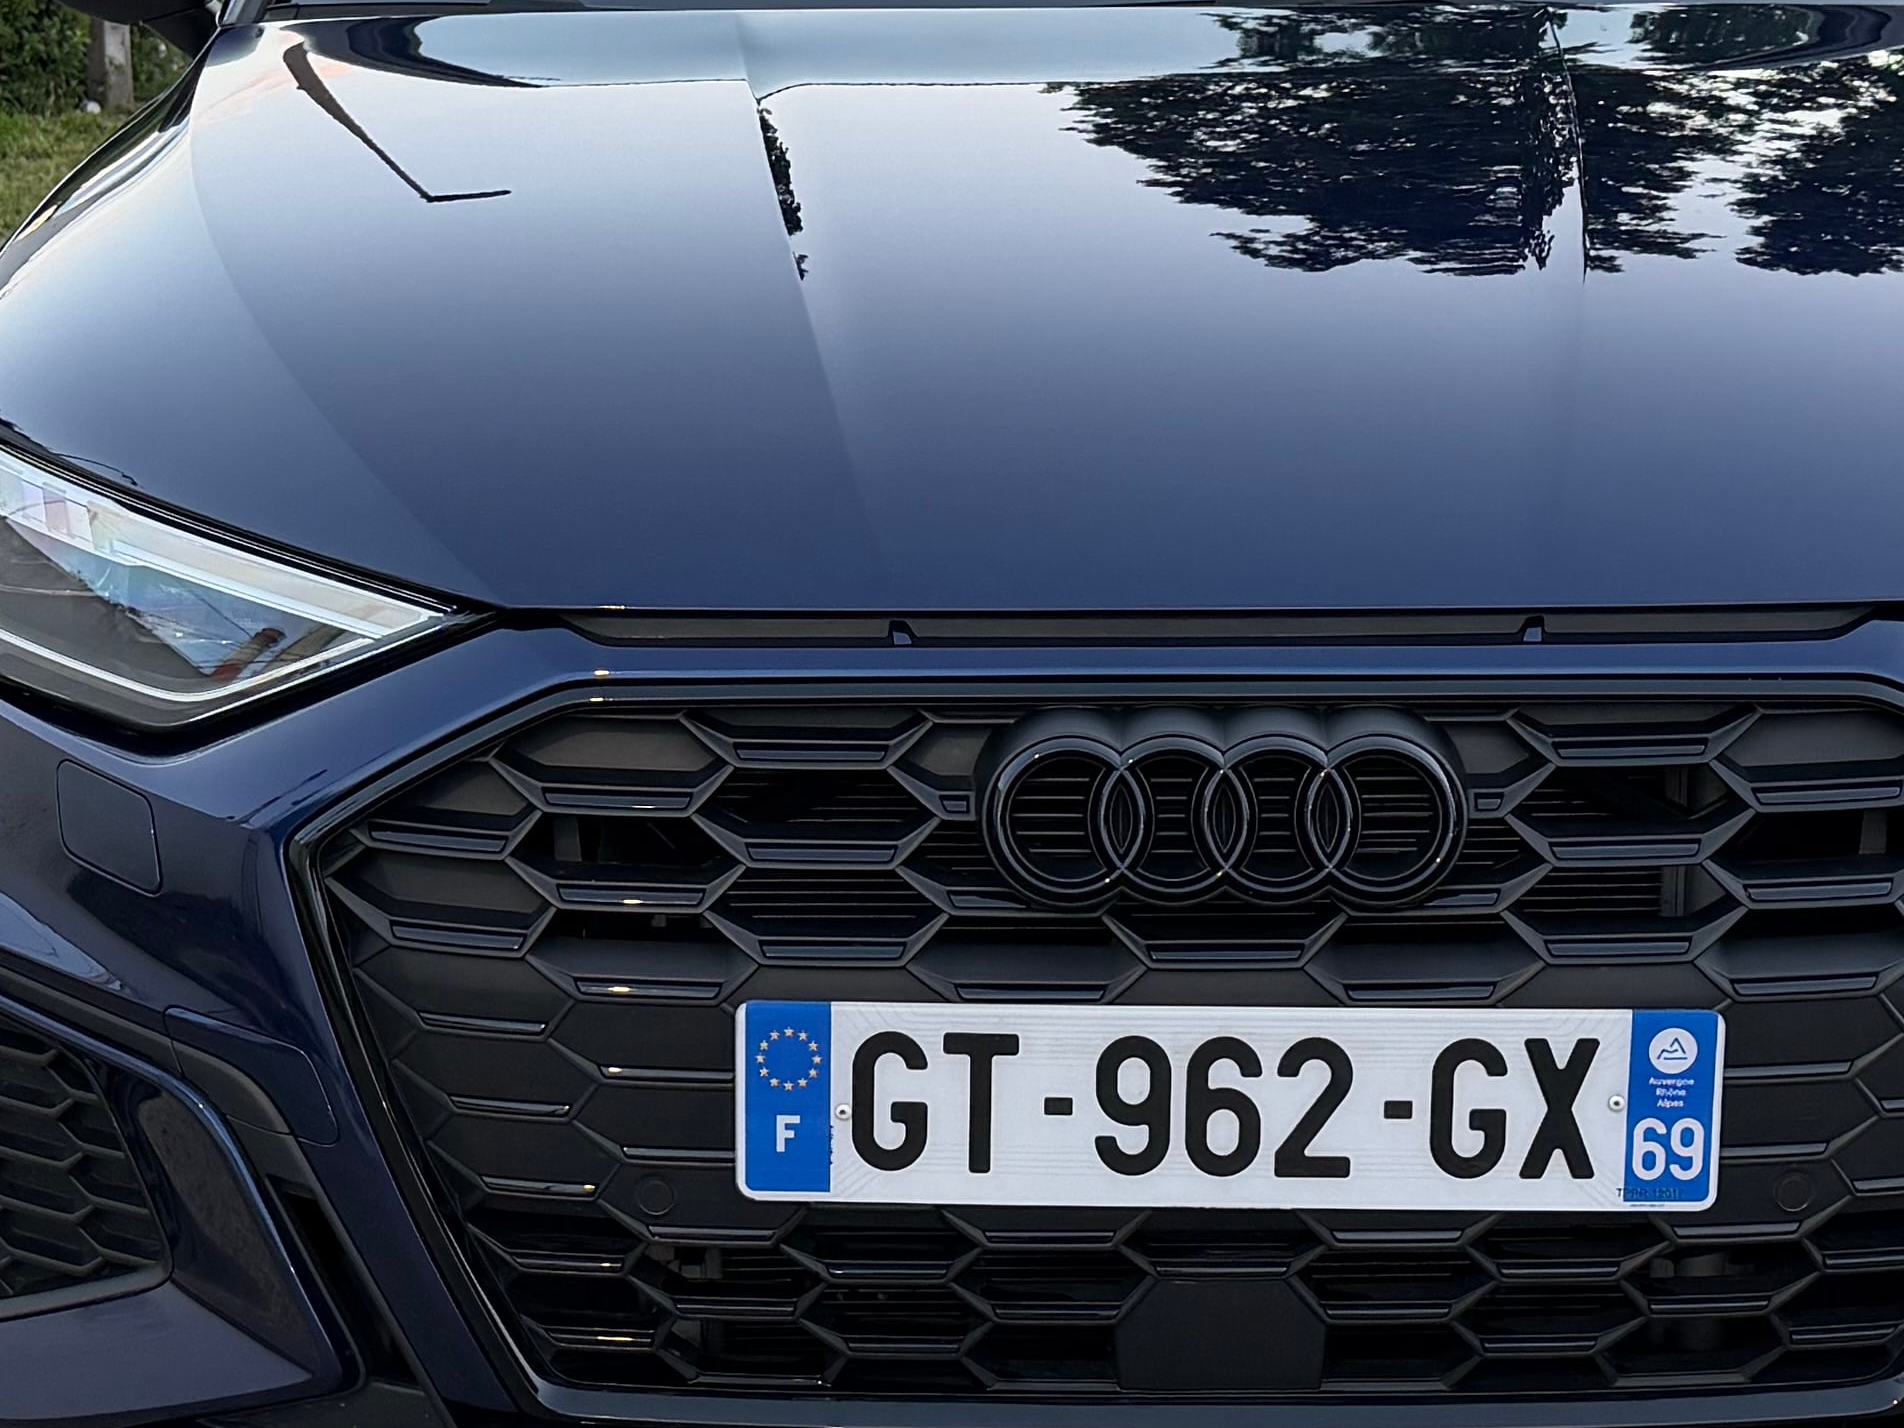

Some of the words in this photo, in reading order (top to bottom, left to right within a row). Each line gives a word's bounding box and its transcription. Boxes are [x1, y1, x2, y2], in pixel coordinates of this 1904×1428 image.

[1649, 1077, 1695, 1086] Auvergne
[852, 1031, 1601, 1180] GT-962-GX
[1657, 1098, 1684, 1108] Alpes
[776, 1115, 800, 1152] F
[1632, 1117, 1705, 1180] 69
